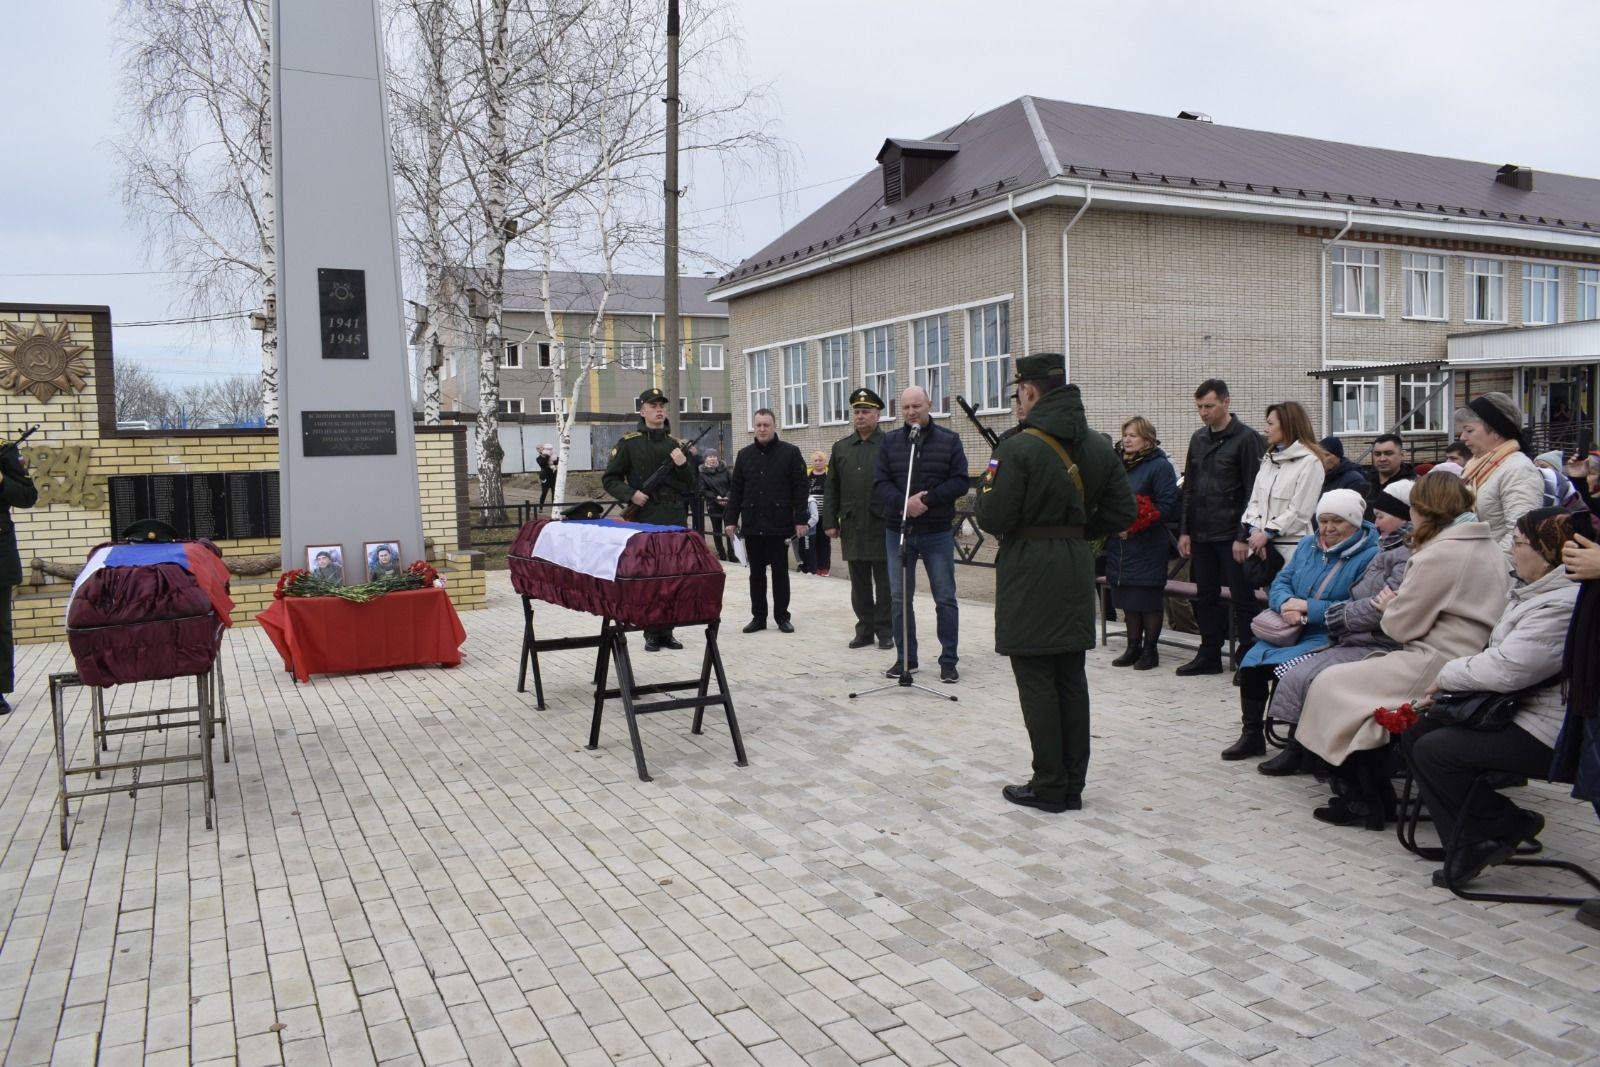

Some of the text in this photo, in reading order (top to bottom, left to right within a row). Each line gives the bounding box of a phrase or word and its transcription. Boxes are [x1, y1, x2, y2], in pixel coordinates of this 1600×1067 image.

[329, 317, 359, 329] 1941
[330, 333, 361, 345] 1945
[32, 474, 107, 509] 945
